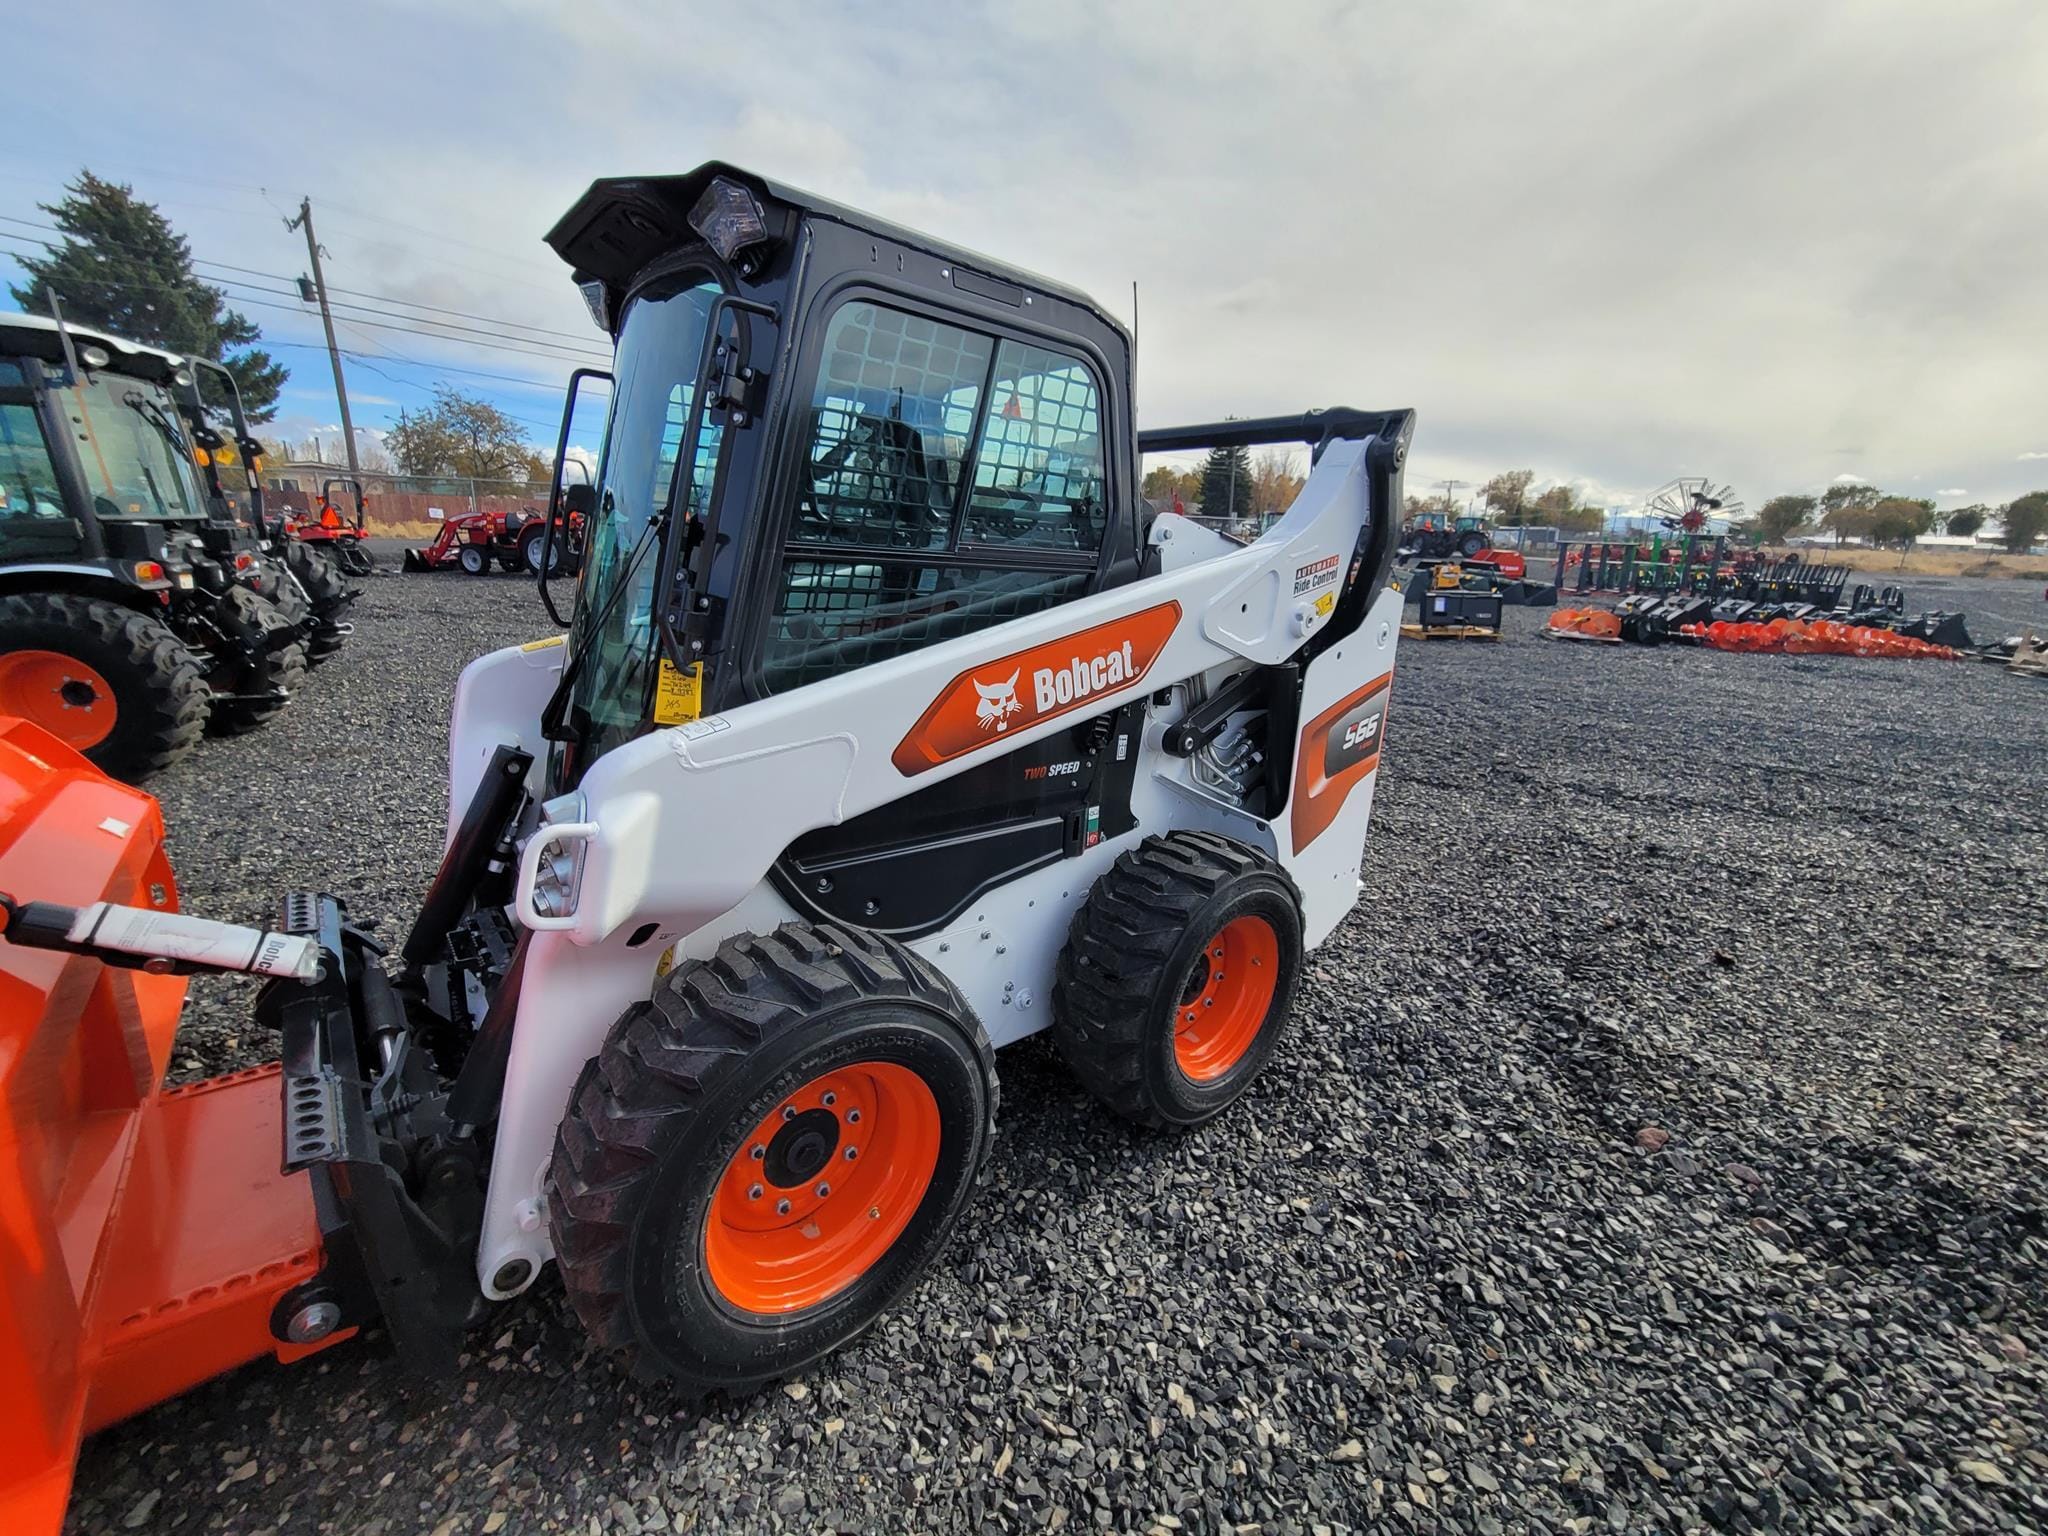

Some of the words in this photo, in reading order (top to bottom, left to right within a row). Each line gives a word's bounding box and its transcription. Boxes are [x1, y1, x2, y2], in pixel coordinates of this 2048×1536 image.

[1294, 579, 1311, 595] Ride
[1312, 566, 1339, 588] Control
[1296, 556, 1339, 579] AUTOMATIC
[1033, 640, 1134, 714] Bobcat
[1342, 712, 1380, 750] S66
[1024, 766, 1047, 780] TWO
[1048, 761, 1080, 777] SPEED
